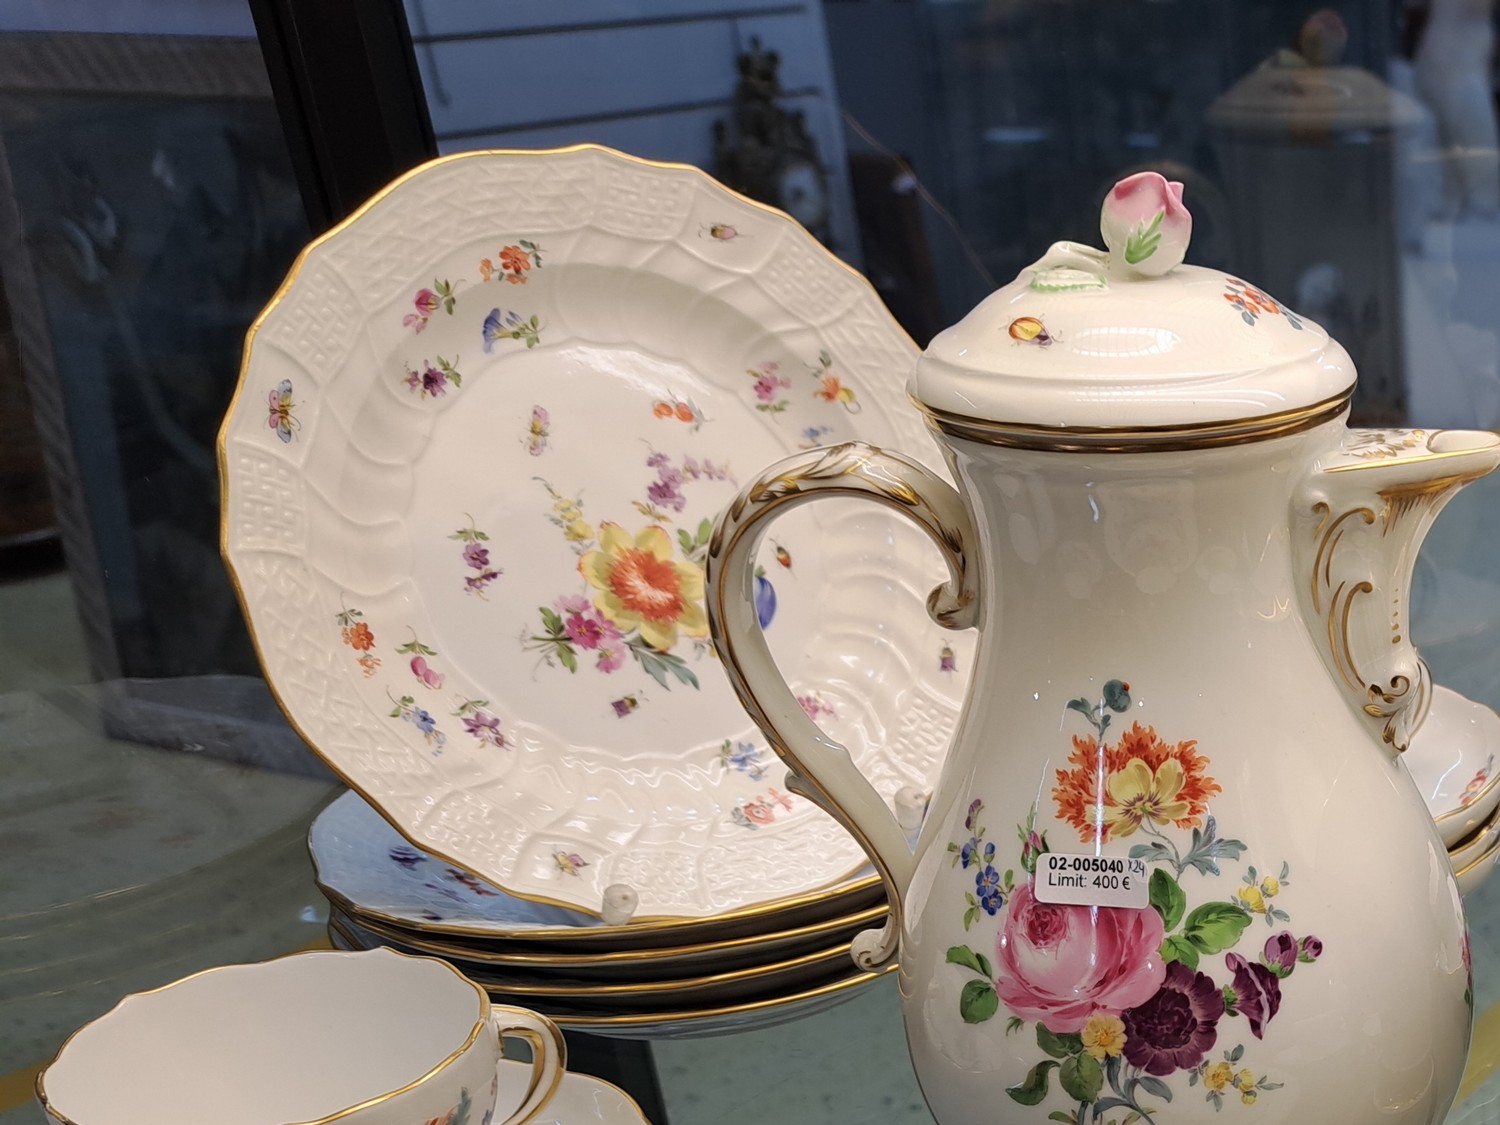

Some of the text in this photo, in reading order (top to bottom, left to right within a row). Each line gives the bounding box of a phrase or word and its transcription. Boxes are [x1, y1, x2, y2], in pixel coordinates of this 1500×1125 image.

[1049, 857, 1124, 873] 02-005040
[1049, 873, 1131, 890] Limit: 400 €
